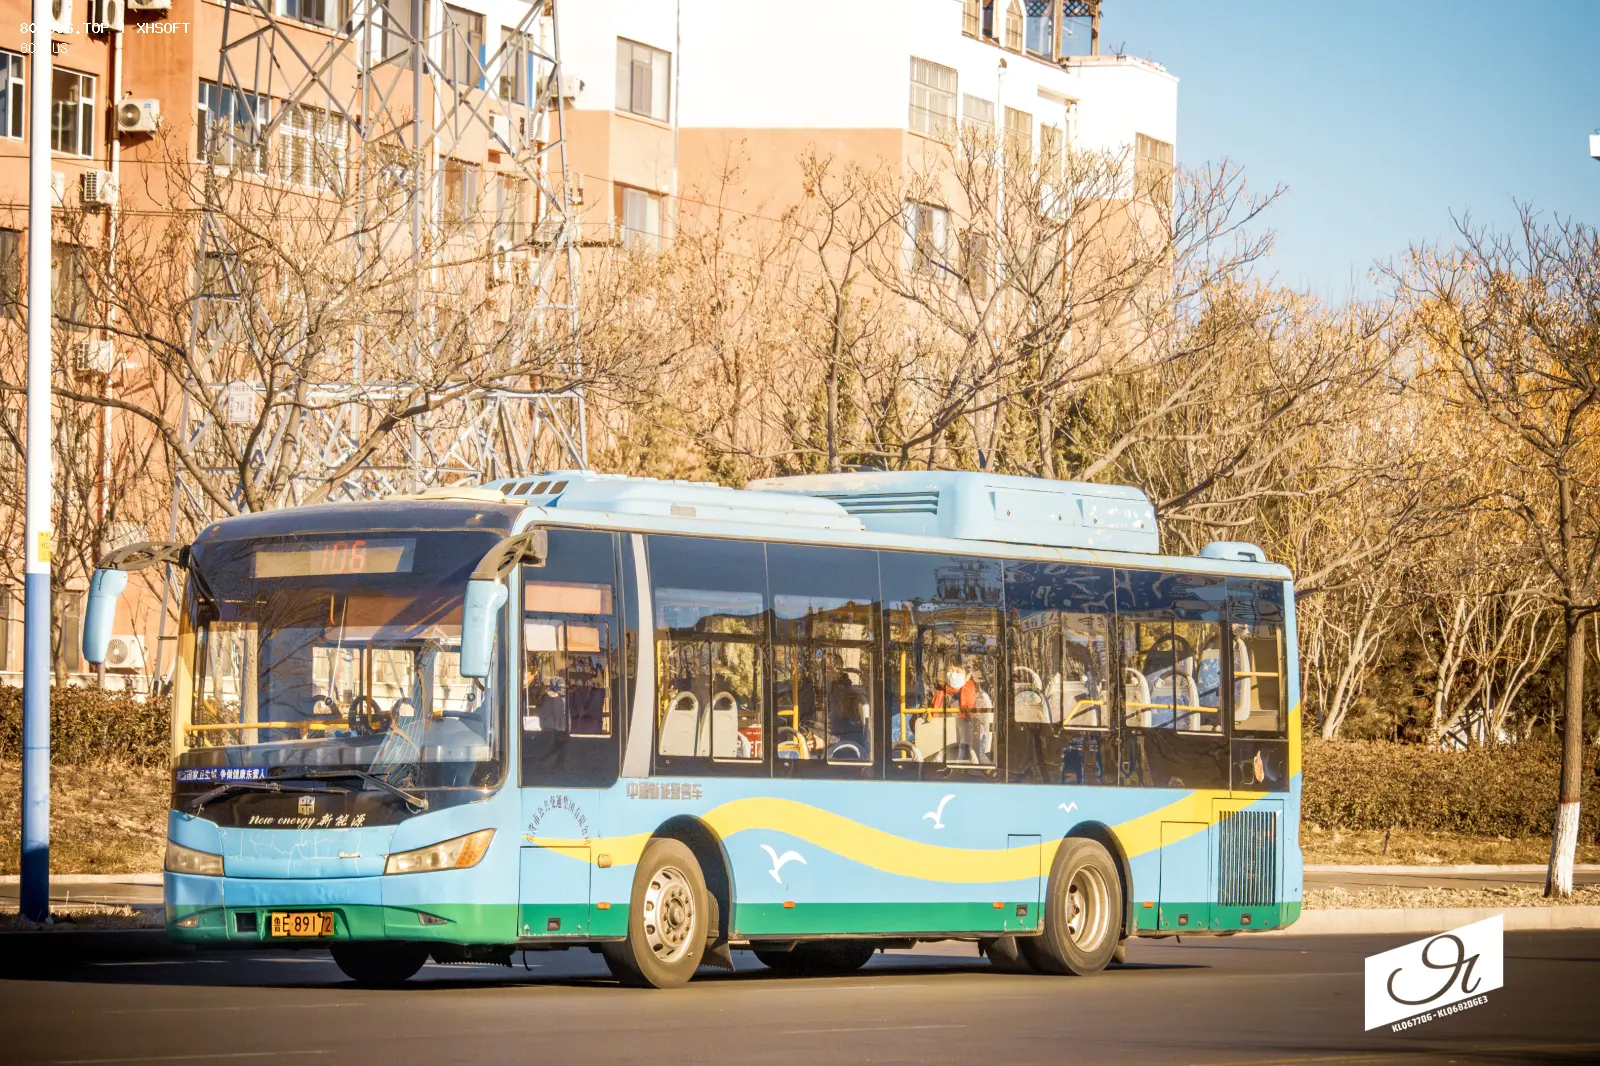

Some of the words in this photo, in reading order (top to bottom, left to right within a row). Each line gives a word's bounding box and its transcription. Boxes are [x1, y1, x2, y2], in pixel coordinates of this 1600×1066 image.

[320, 540, 367, 573] 106
[248, 814, 275, 825] New
[277, 816, 317, 830] energy
[316, 812, 367, 828] 新能源
